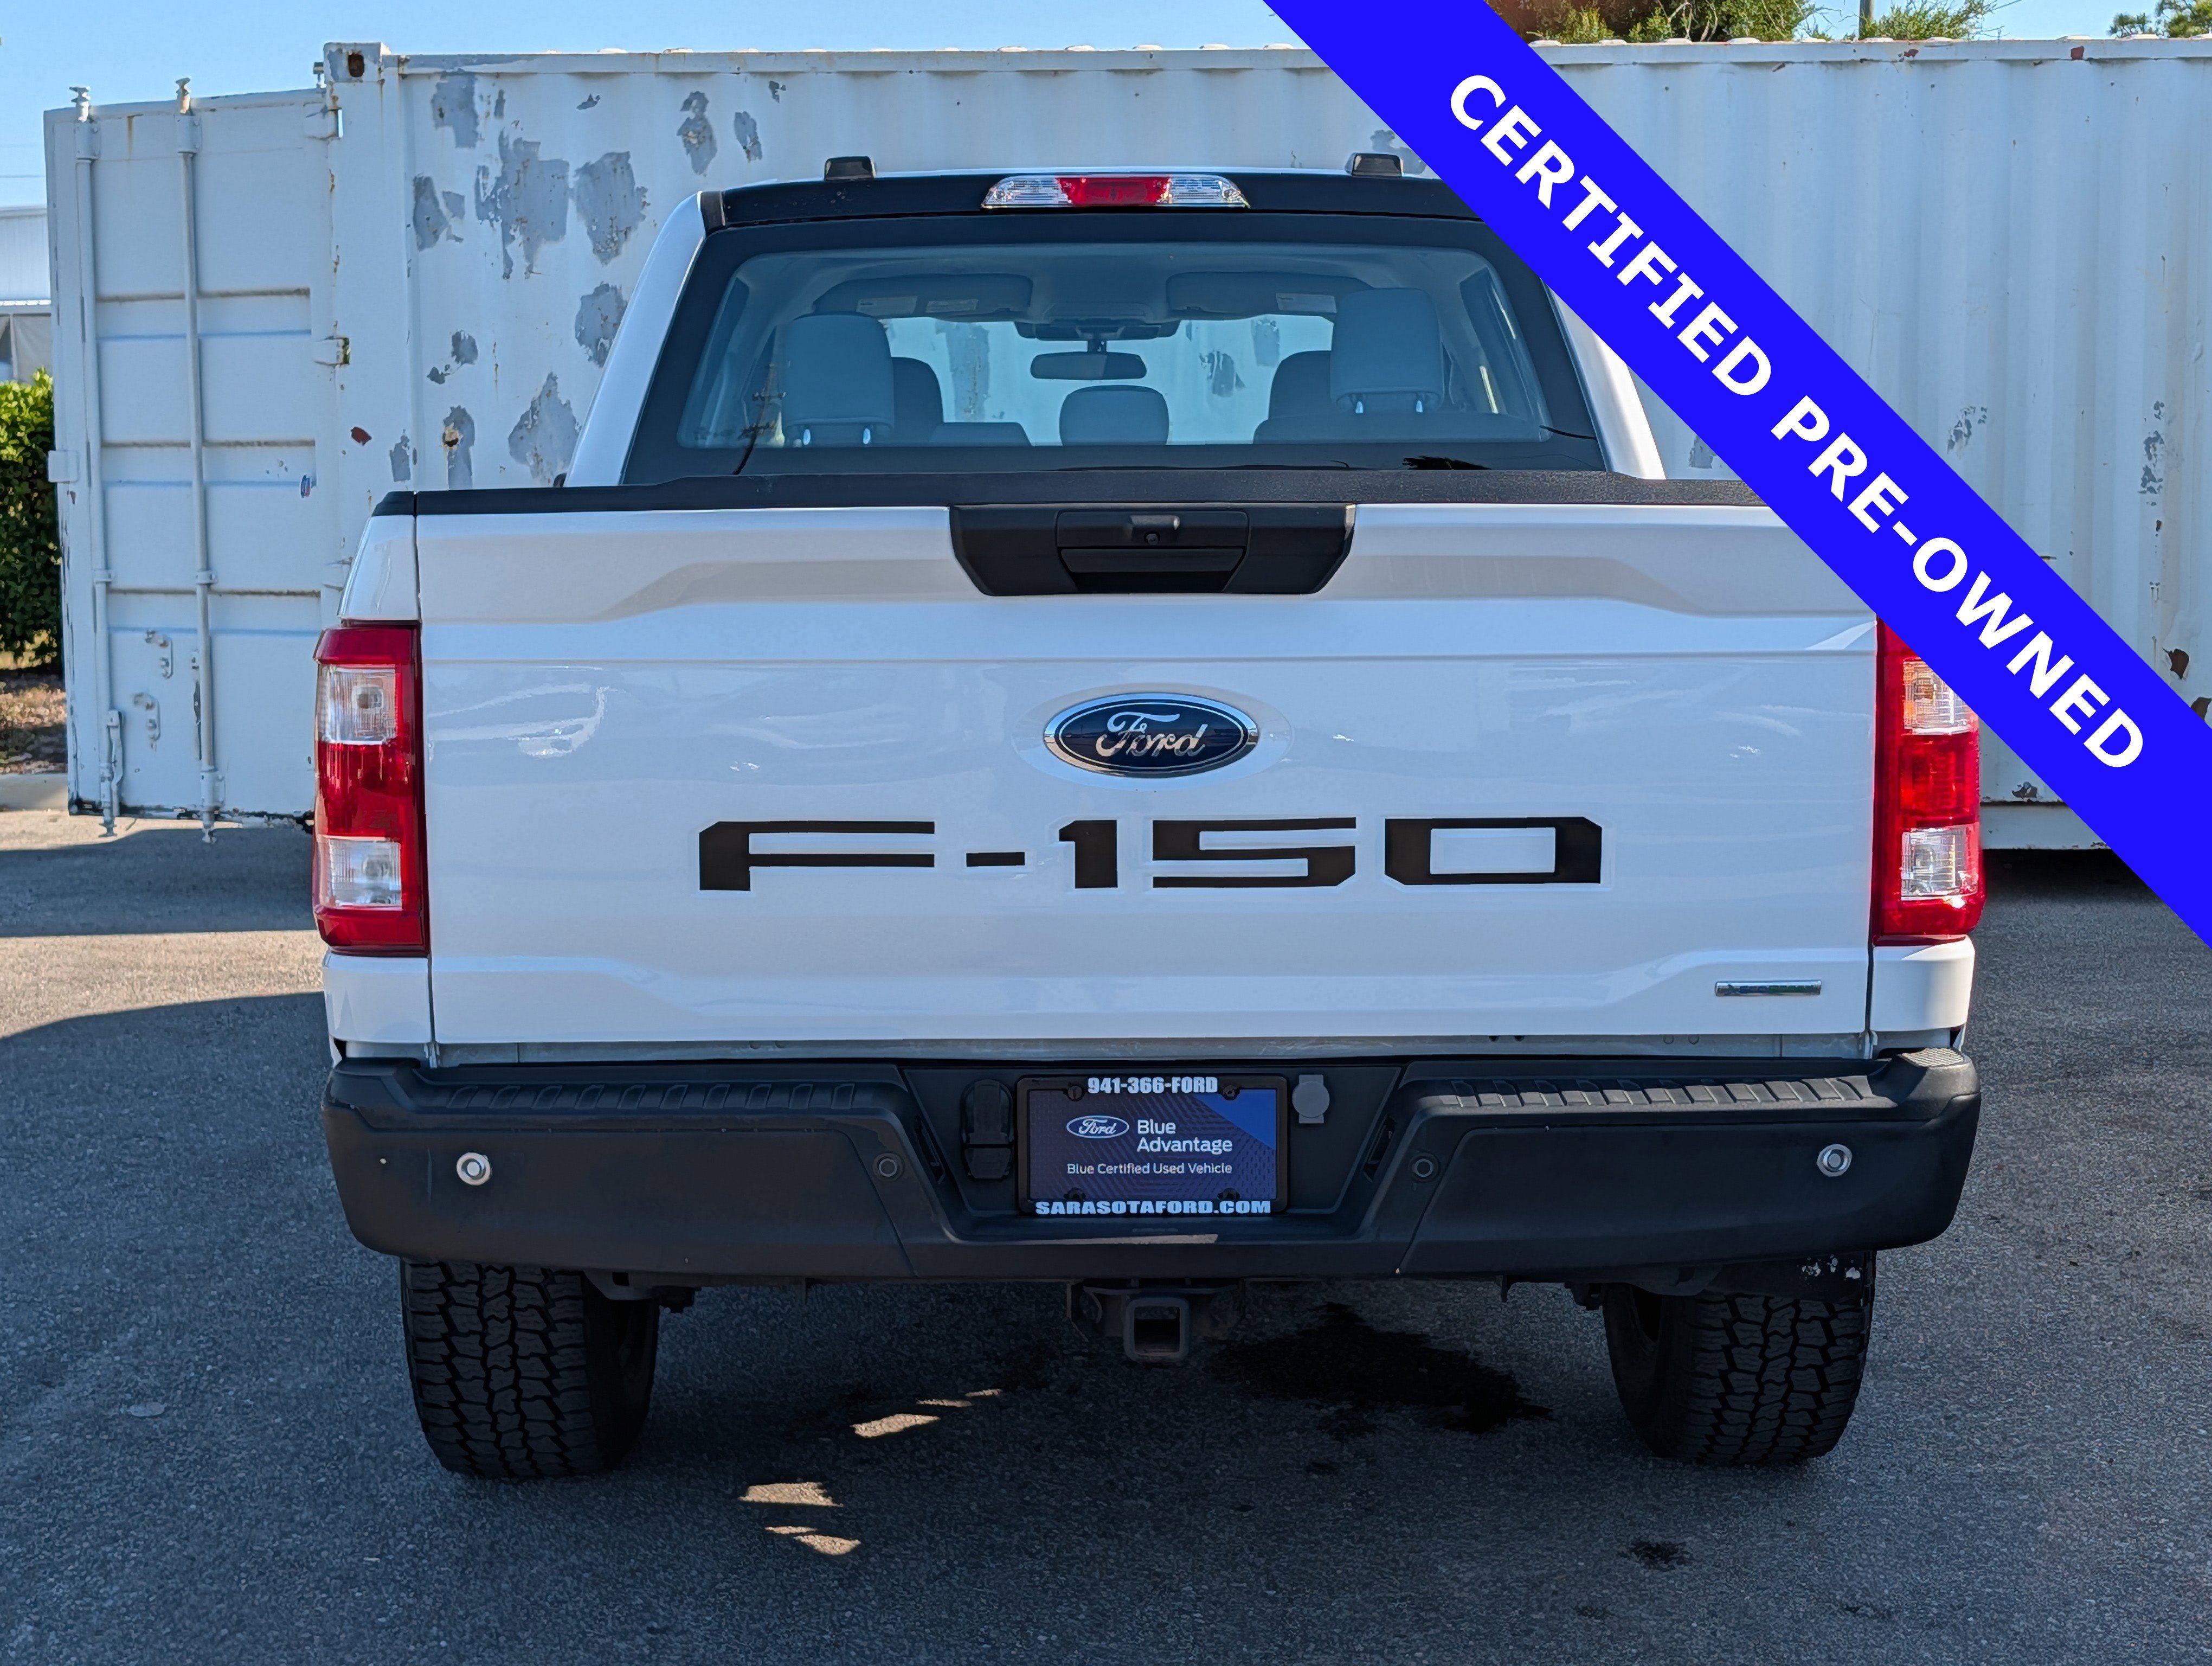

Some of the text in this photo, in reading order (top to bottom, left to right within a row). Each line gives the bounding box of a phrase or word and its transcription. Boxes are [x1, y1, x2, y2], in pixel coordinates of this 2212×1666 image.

[1096, 712, 1208, 757] Ford
[699, 817, 1602, 891] F-150
[1088, 1077, 1218, 1094] 941-366-FORD
[1078, 1119, 1117, 1135] Ford
[1137, 1119, 1176, 1134] Blue
[1136, 1137, 1233, 1155] Advantage
[1067, 1162, 1232, 1174] Blue Certified Used Vehicle
[1036, 1200, 1271, 1214] SARASOTAFORD.COM
